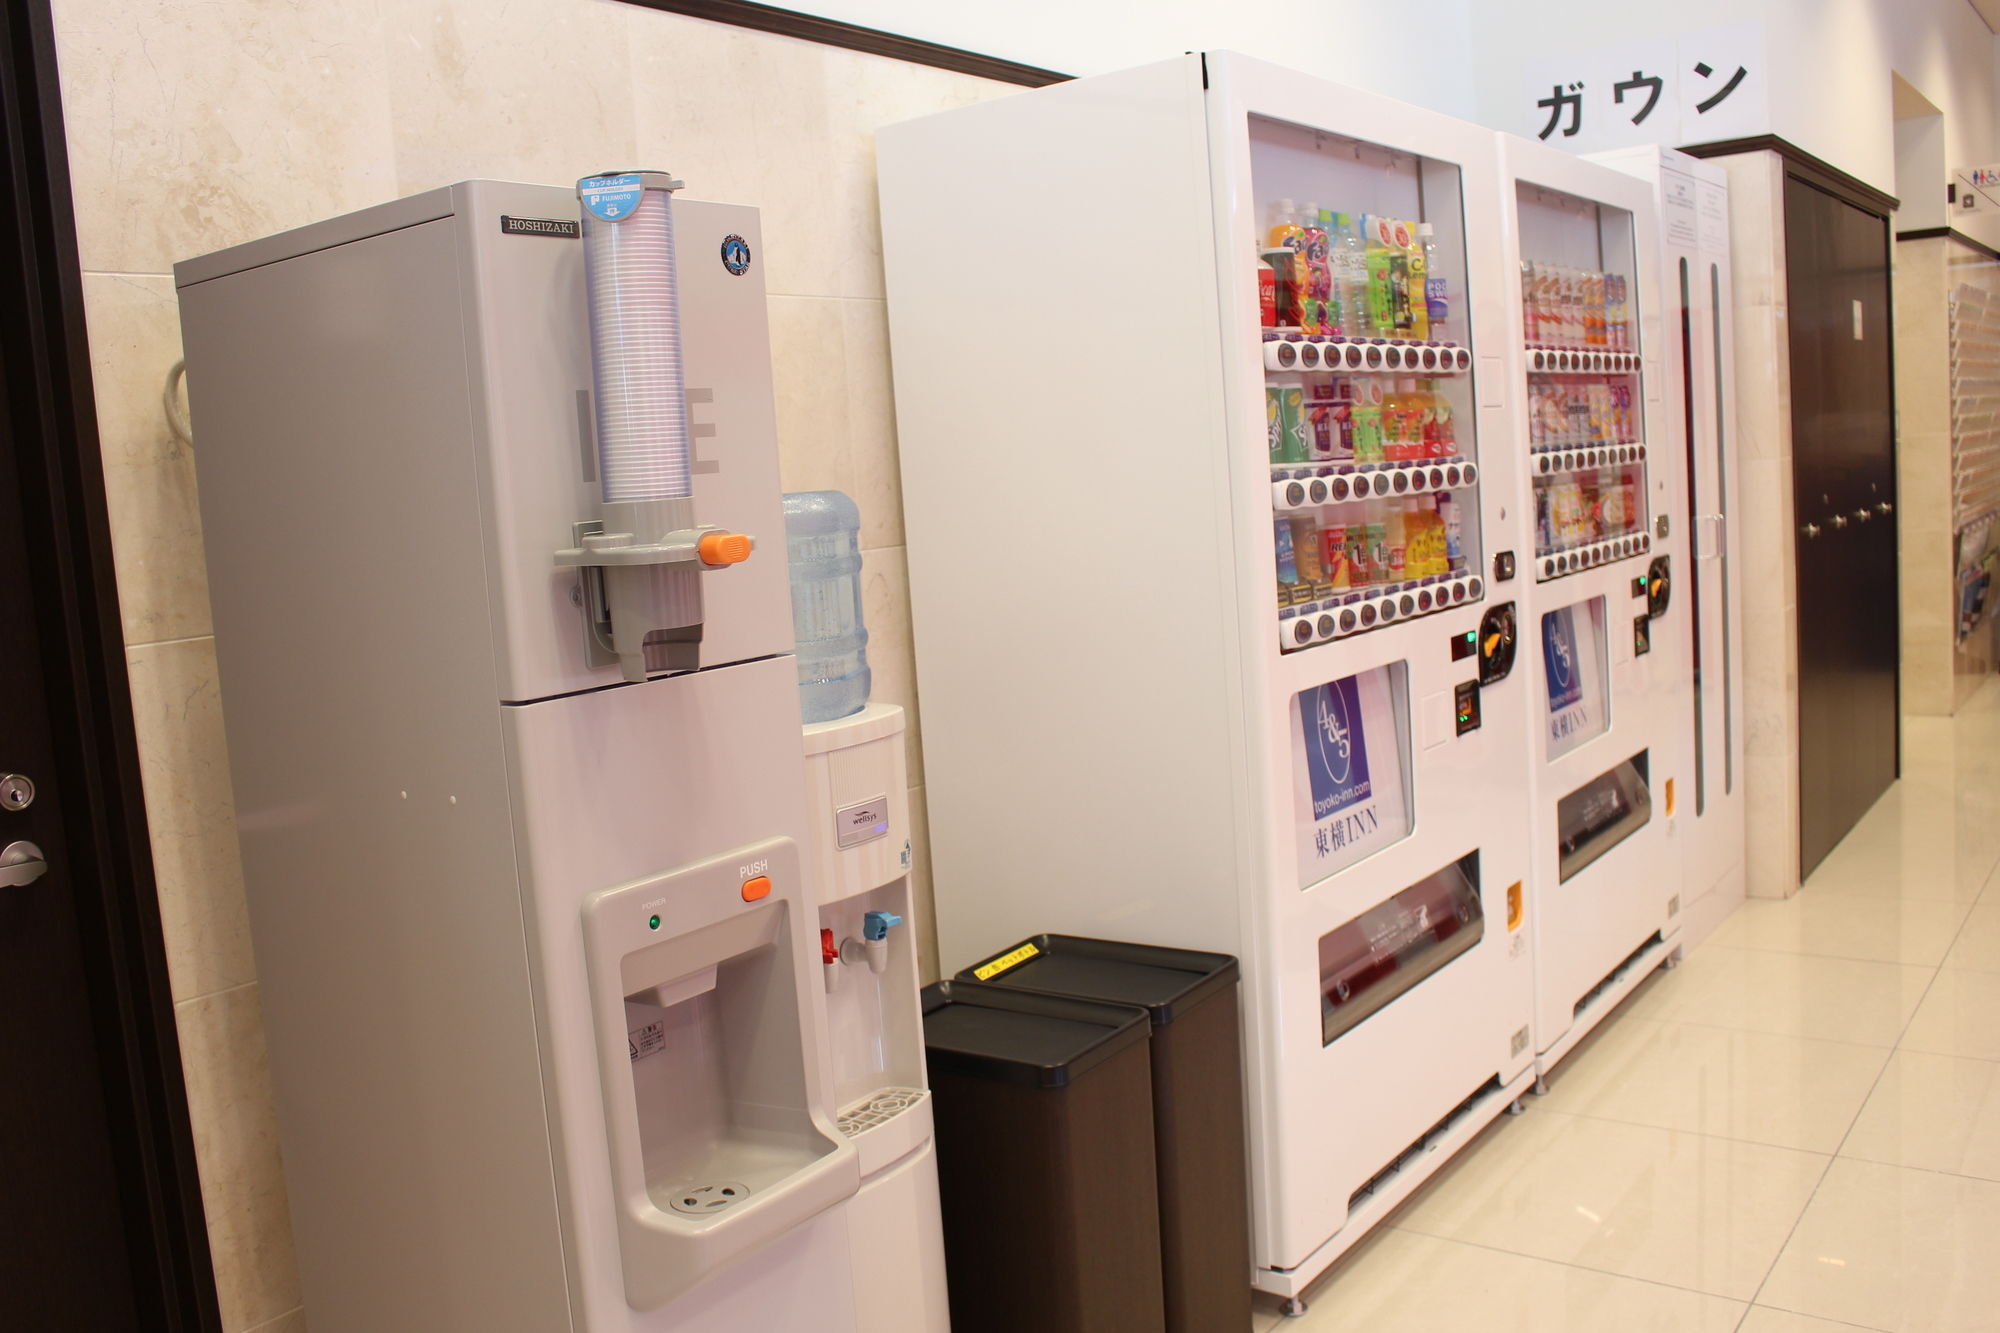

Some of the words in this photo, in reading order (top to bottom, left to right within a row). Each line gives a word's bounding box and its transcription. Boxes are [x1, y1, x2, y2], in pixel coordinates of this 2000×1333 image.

[1537, 61, 1748, 142] ガウン
[508, 219, 574, 234] HOSHIZAKI
[1314, 780, 1371, 814] toyoko-inn.com
[1314, 805, 1379, 859] 東横INN
[739, 858, 768, 879] PUSH
[642, 897, 667, 911] POWER
